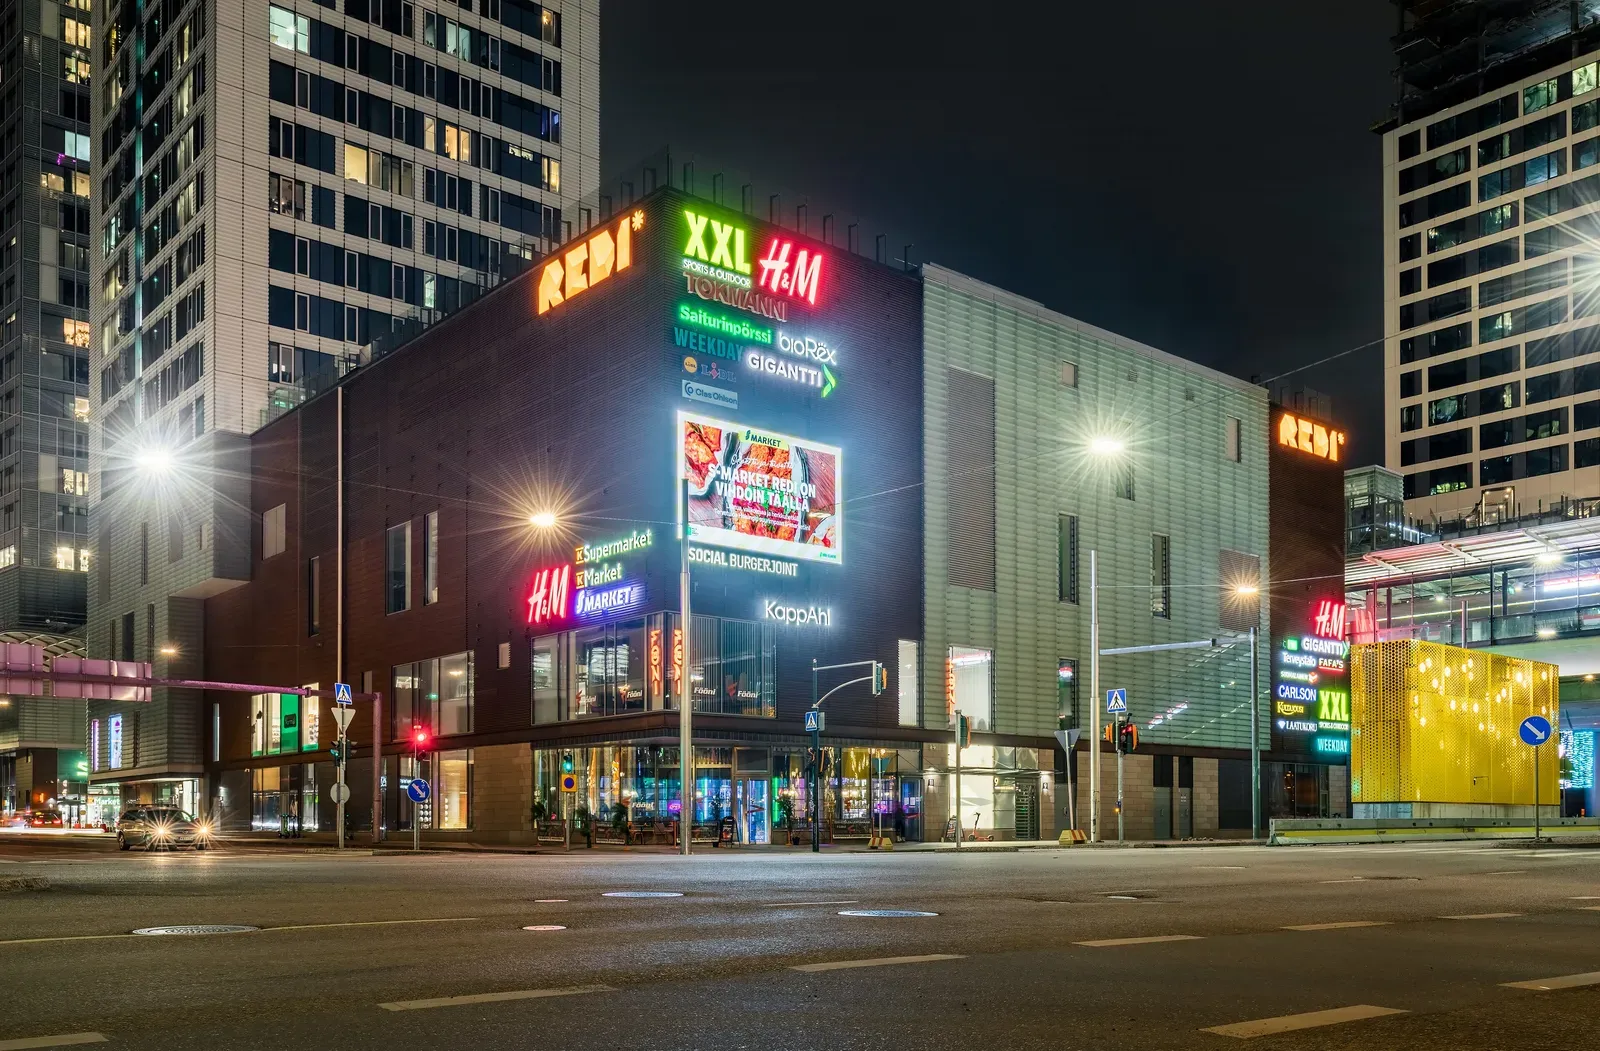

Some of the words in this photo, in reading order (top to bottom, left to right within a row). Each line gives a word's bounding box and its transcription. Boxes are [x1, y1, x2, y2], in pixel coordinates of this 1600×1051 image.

[684, 210, 751, 275] XXL
[683, 259, 709, 275] SPORTS
[709, 267, 716, 277] &
[715, 270, 751, 288] OUTDOOR
[760, 239, 822, 305] H&M
[683, 271, 787, 322] TOKMANNI
[680, 305, 772, 344] Saiturinpörssi
[674, 327, 744, 362] WEEKDAY
[749, 353, 822, 388] GIGANTTI
[695, 388, 712, 399] Clas
[712, 392, 738, 406] Ohlson
[750, 434, 781, 448] MARKET
[708, 463, 770, 489] S-MARKET
[771, 476, 799, 496] REDI
[800, 482, 816, 499] ON
[715, 480, 766, 502] VIHDOIN
[766, 490, 810, 513] TÄÄLLÄ
[583, 529, 652, 562] Supermarket
[584, 563, 622, 587] Market
[688, 547, 728, 567] SOCIAL
[729, 553, 798, 577] BURGERJOINT
[528, 564, 569, 623] H&M
[584, 586, 632, 612] MARKET
[764, 600, 831, 626] KappAhl
[1315, 601, 1346, 641] H&M
[1303, 637, 1342, 656] GIGANTTI
[1318, 657, 1344, 669] FAFA'S
[1279, 684, 1317, 702] CARLSON
[1319, 690, 1349, 722] XXL
[1317, 738, 1348, 752] WEEKDAY
